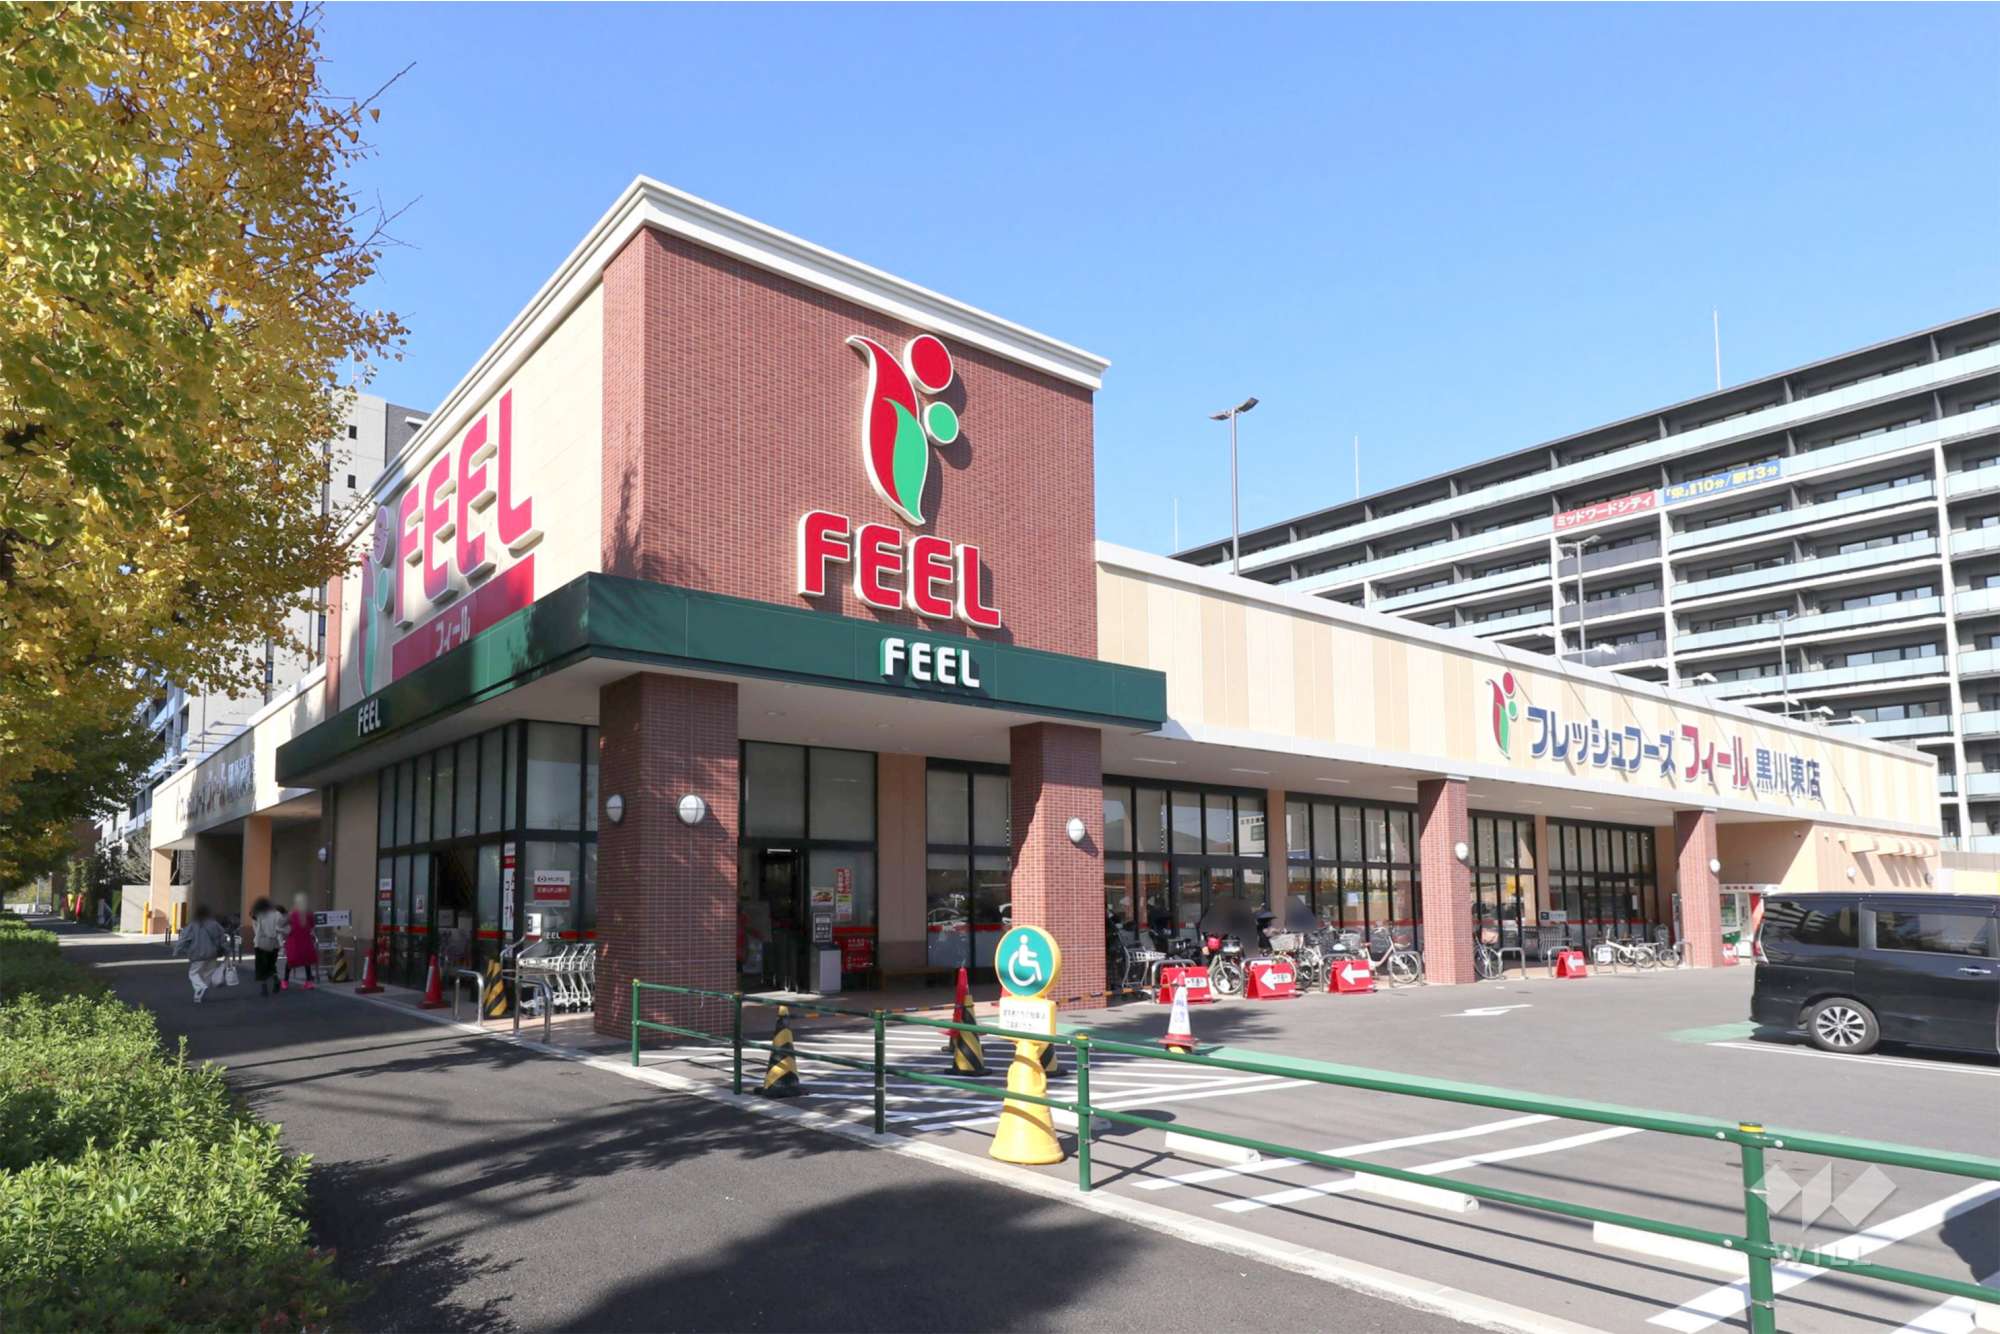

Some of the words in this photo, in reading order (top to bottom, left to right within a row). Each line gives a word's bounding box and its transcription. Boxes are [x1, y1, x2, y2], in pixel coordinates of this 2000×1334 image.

[393, 387, 534, 627] FEEL
[1556, 494, 1653, 527] ミッドワードシティ
[799, 509, 1001, 629] FEEL
[436, 606, 471, 658] フィール
[881, 637, 980, 688] FEEL
[357, 698, 381, 737] FEEL
[1527, 705, 1677, 778] フレッシュフーズ
[1681, 723, 1750, 790] フィール
[1755, 747, 1822, 800] 黒川東店
